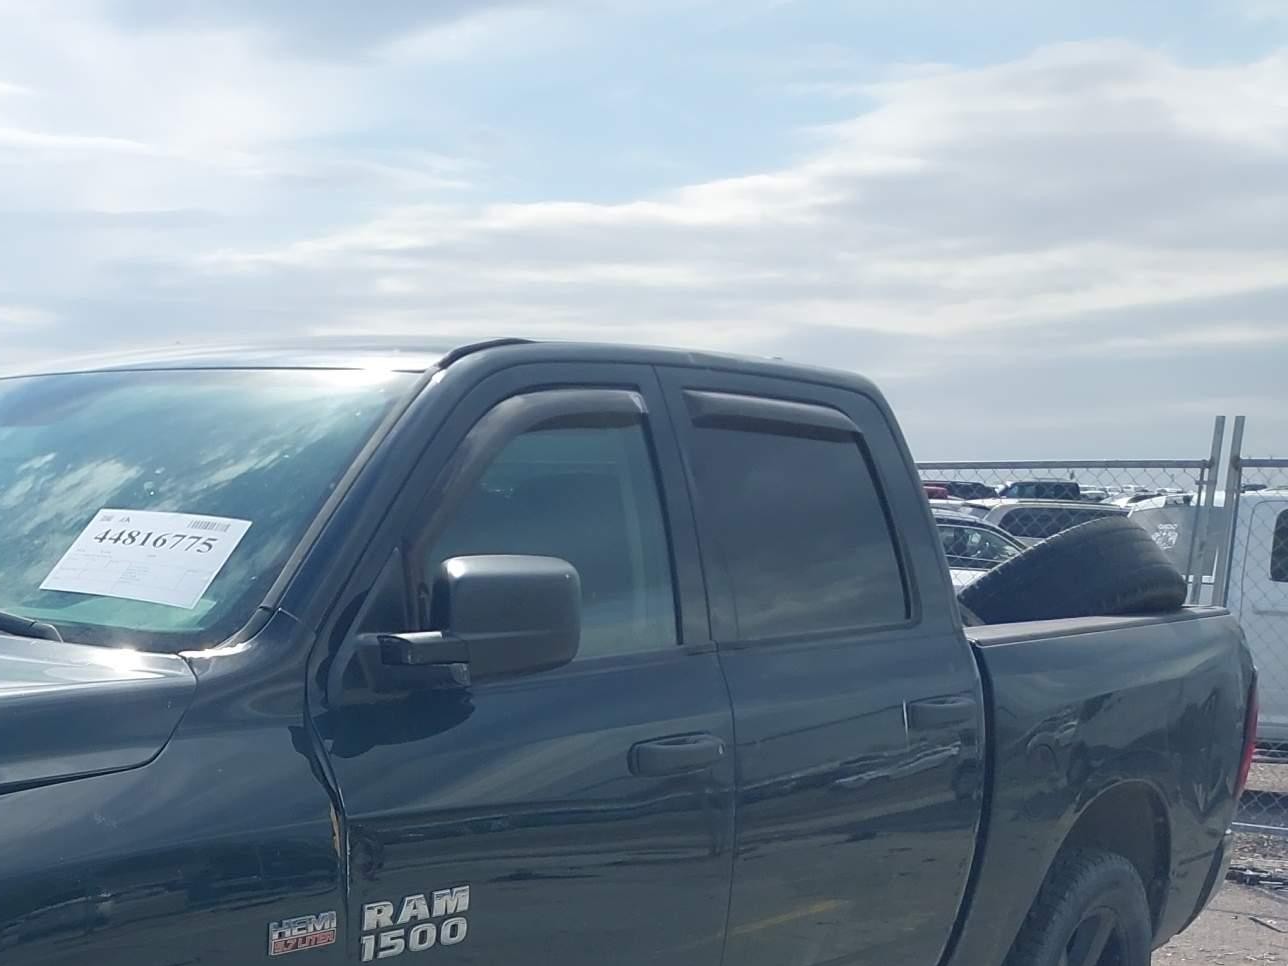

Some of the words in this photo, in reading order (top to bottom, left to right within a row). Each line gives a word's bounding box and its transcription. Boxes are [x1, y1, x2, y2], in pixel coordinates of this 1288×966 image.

[93, 527, 218, 554] 44816775
[362, 885, 470, 931] RAM
[269, 911, 337, 940] HEMI
[297, 930, 334, 949] LITER
[360, 916, 468, 962] 1500
